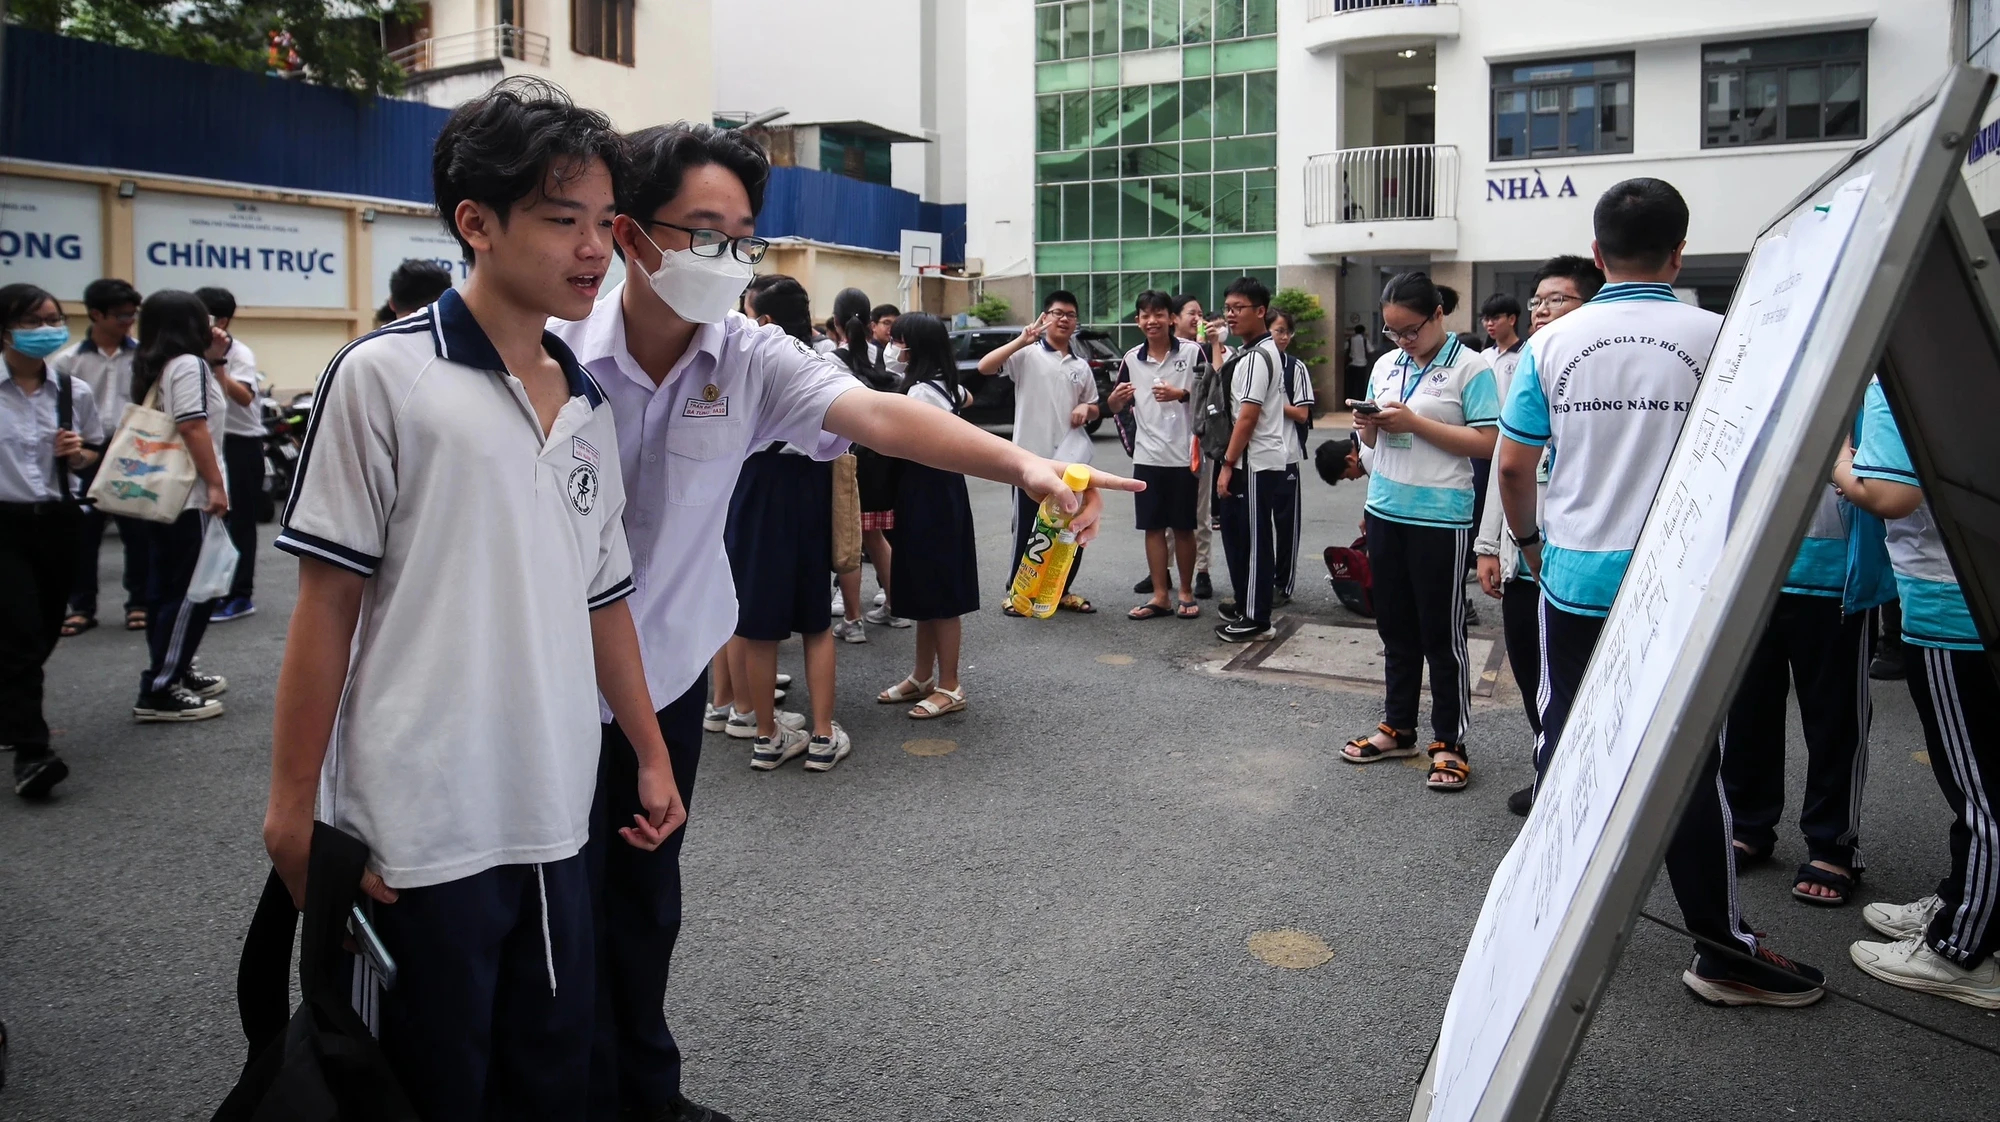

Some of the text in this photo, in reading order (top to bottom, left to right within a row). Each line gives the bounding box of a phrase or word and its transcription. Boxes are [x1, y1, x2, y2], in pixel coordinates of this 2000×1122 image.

[1486, 167, 1578, 202] NHÀ A
[0, 230, 82, 266] ỌNG
[146, 238, 335, 281] CHÍNH TRỰC
[1563, 355, 1582, 376] HỌC
[1581, 337, 1612, 358] QUỐC
[1613, 335, 1637, 344] GIA
[1639, 336, 1658, 346] TP.
[1659, 341, 1679, 352] HỒ
[1677, 350, 1698, 368] CHÍ
[1573, 397, 1623, 412] THÔNG
[1627, 397, 1670, 411] NĂNG
